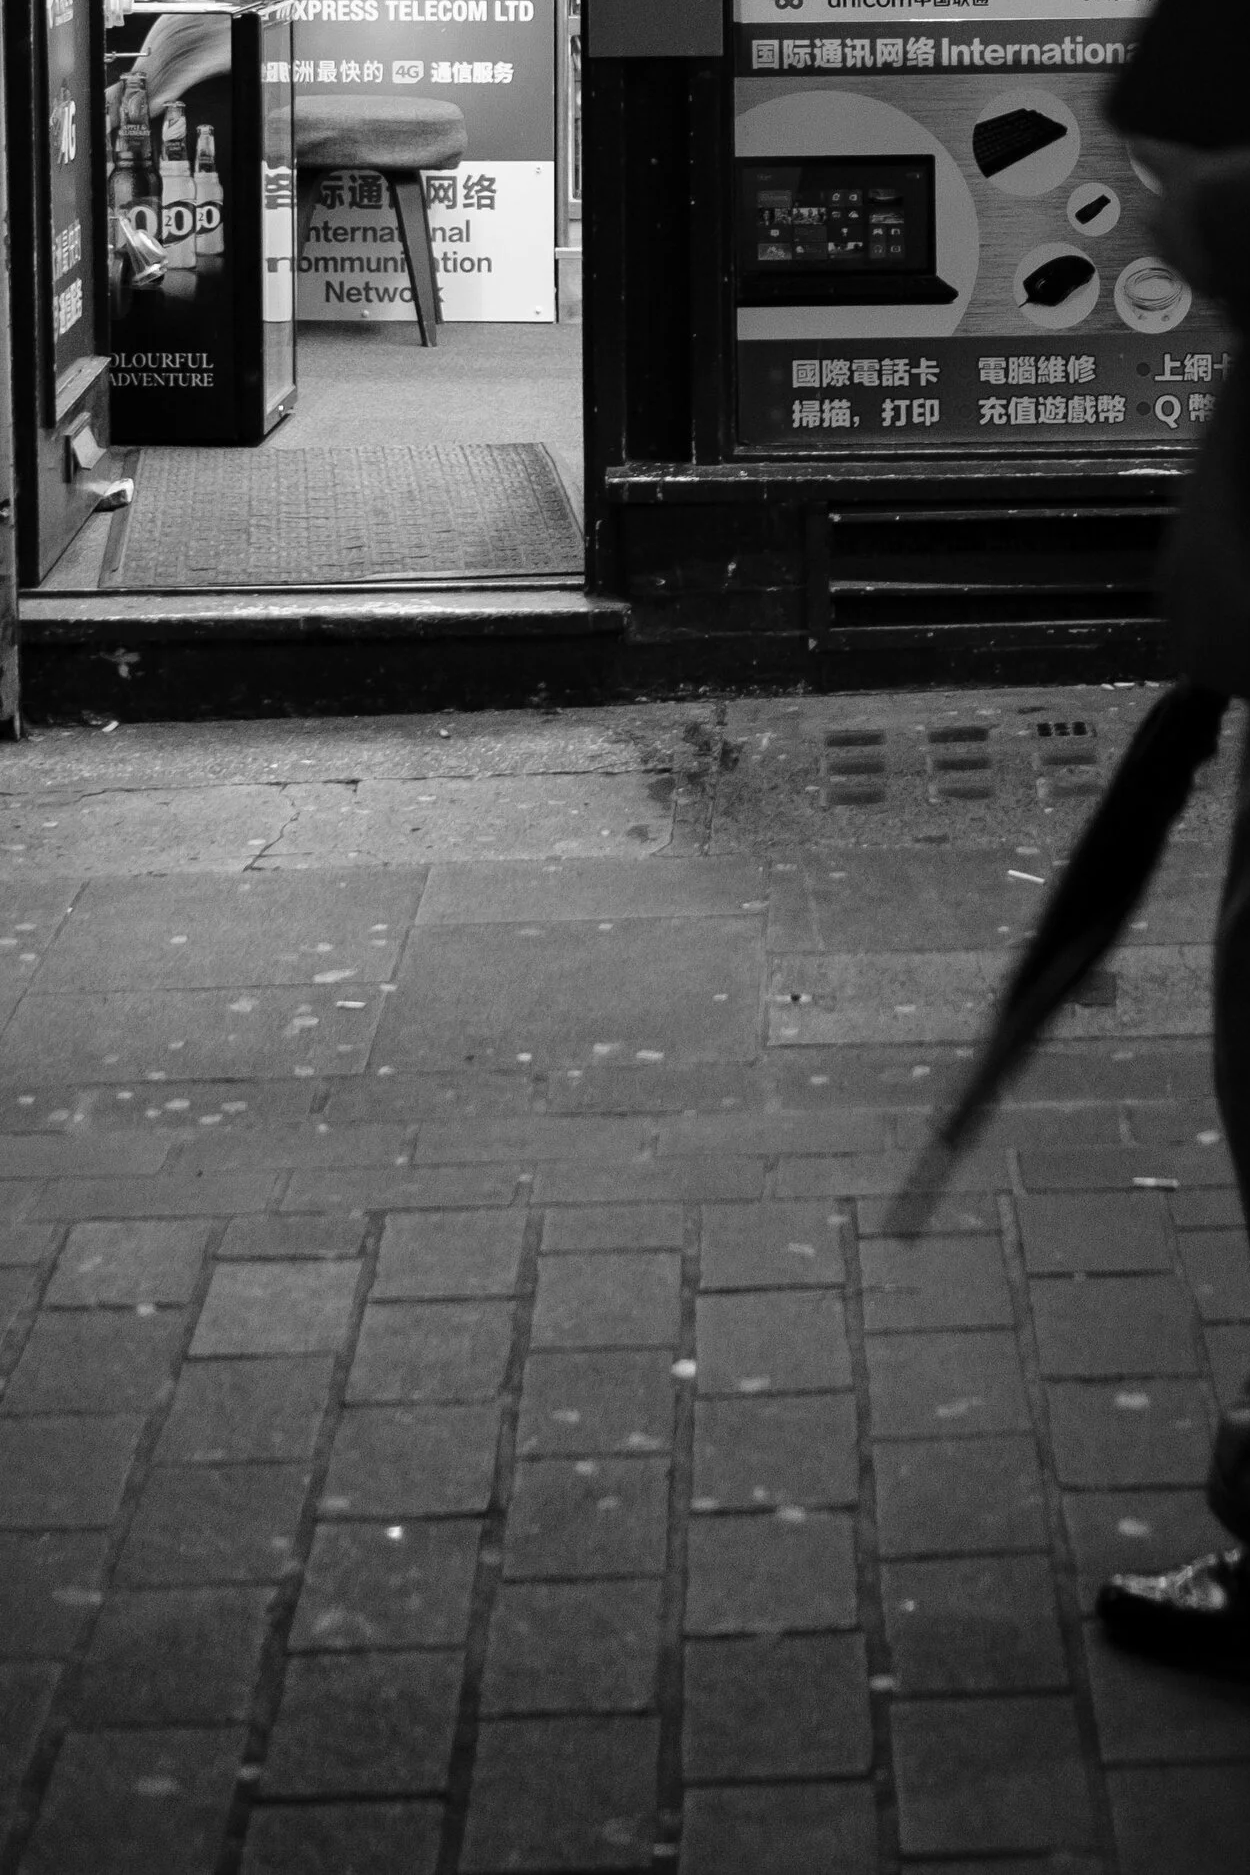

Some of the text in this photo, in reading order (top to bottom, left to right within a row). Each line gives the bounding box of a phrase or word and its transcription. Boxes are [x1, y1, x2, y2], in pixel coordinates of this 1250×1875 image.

[289, 0, 535, 23] XPRESS TELECOM LTD
[750, 37, 936, 69] 国际通讯网络
[394, 64, 420, 79] 4G
[430, 61, 515, 84] 通信服务
[791, 357, 941, 388] 國際電話卡
[977, 353, 1097, 387] 電腦維修
[978, 394, 1126, 426] 充值遊戲幣
[1154, 394, 1182, 429] Q
